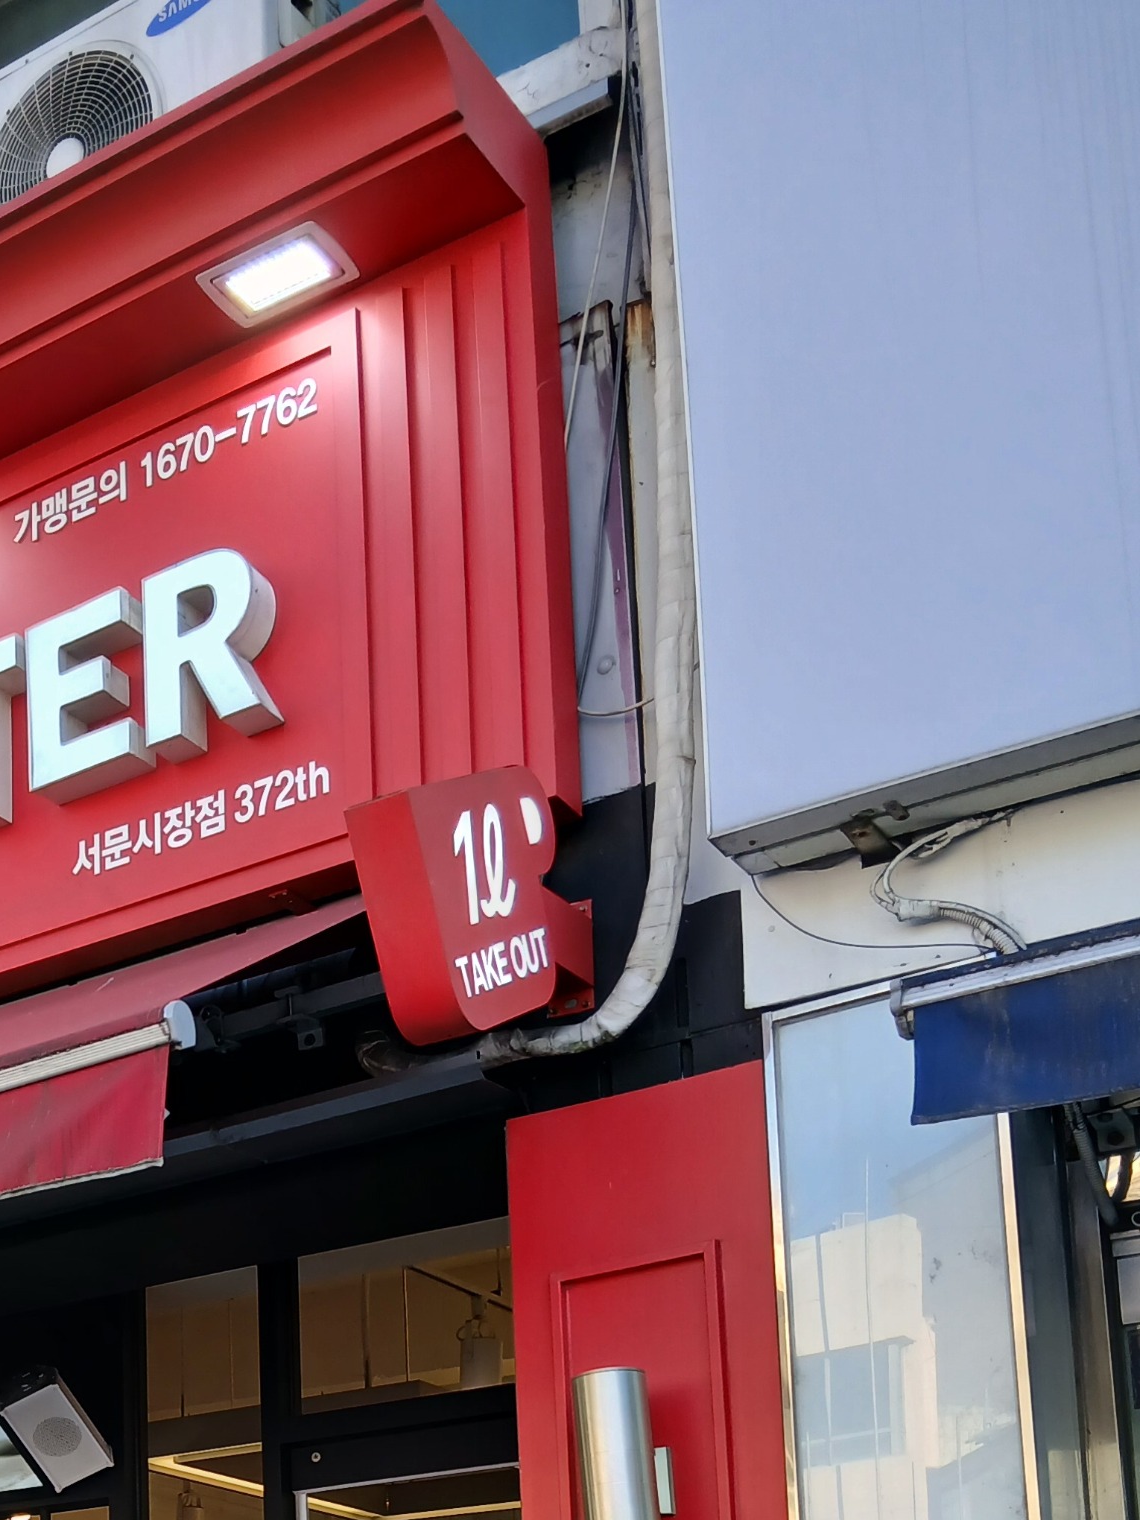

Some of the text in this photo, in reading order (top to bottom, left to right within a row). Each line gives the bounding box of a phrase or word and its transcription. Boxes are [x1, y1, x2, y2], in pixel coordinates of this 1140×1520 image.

[13, 377, 318, 543] 가맹문의 1670-7762
[72, 760, 331, 877] 서문시장점 372th
[455, 927, 549, 998] TAKE OUT
